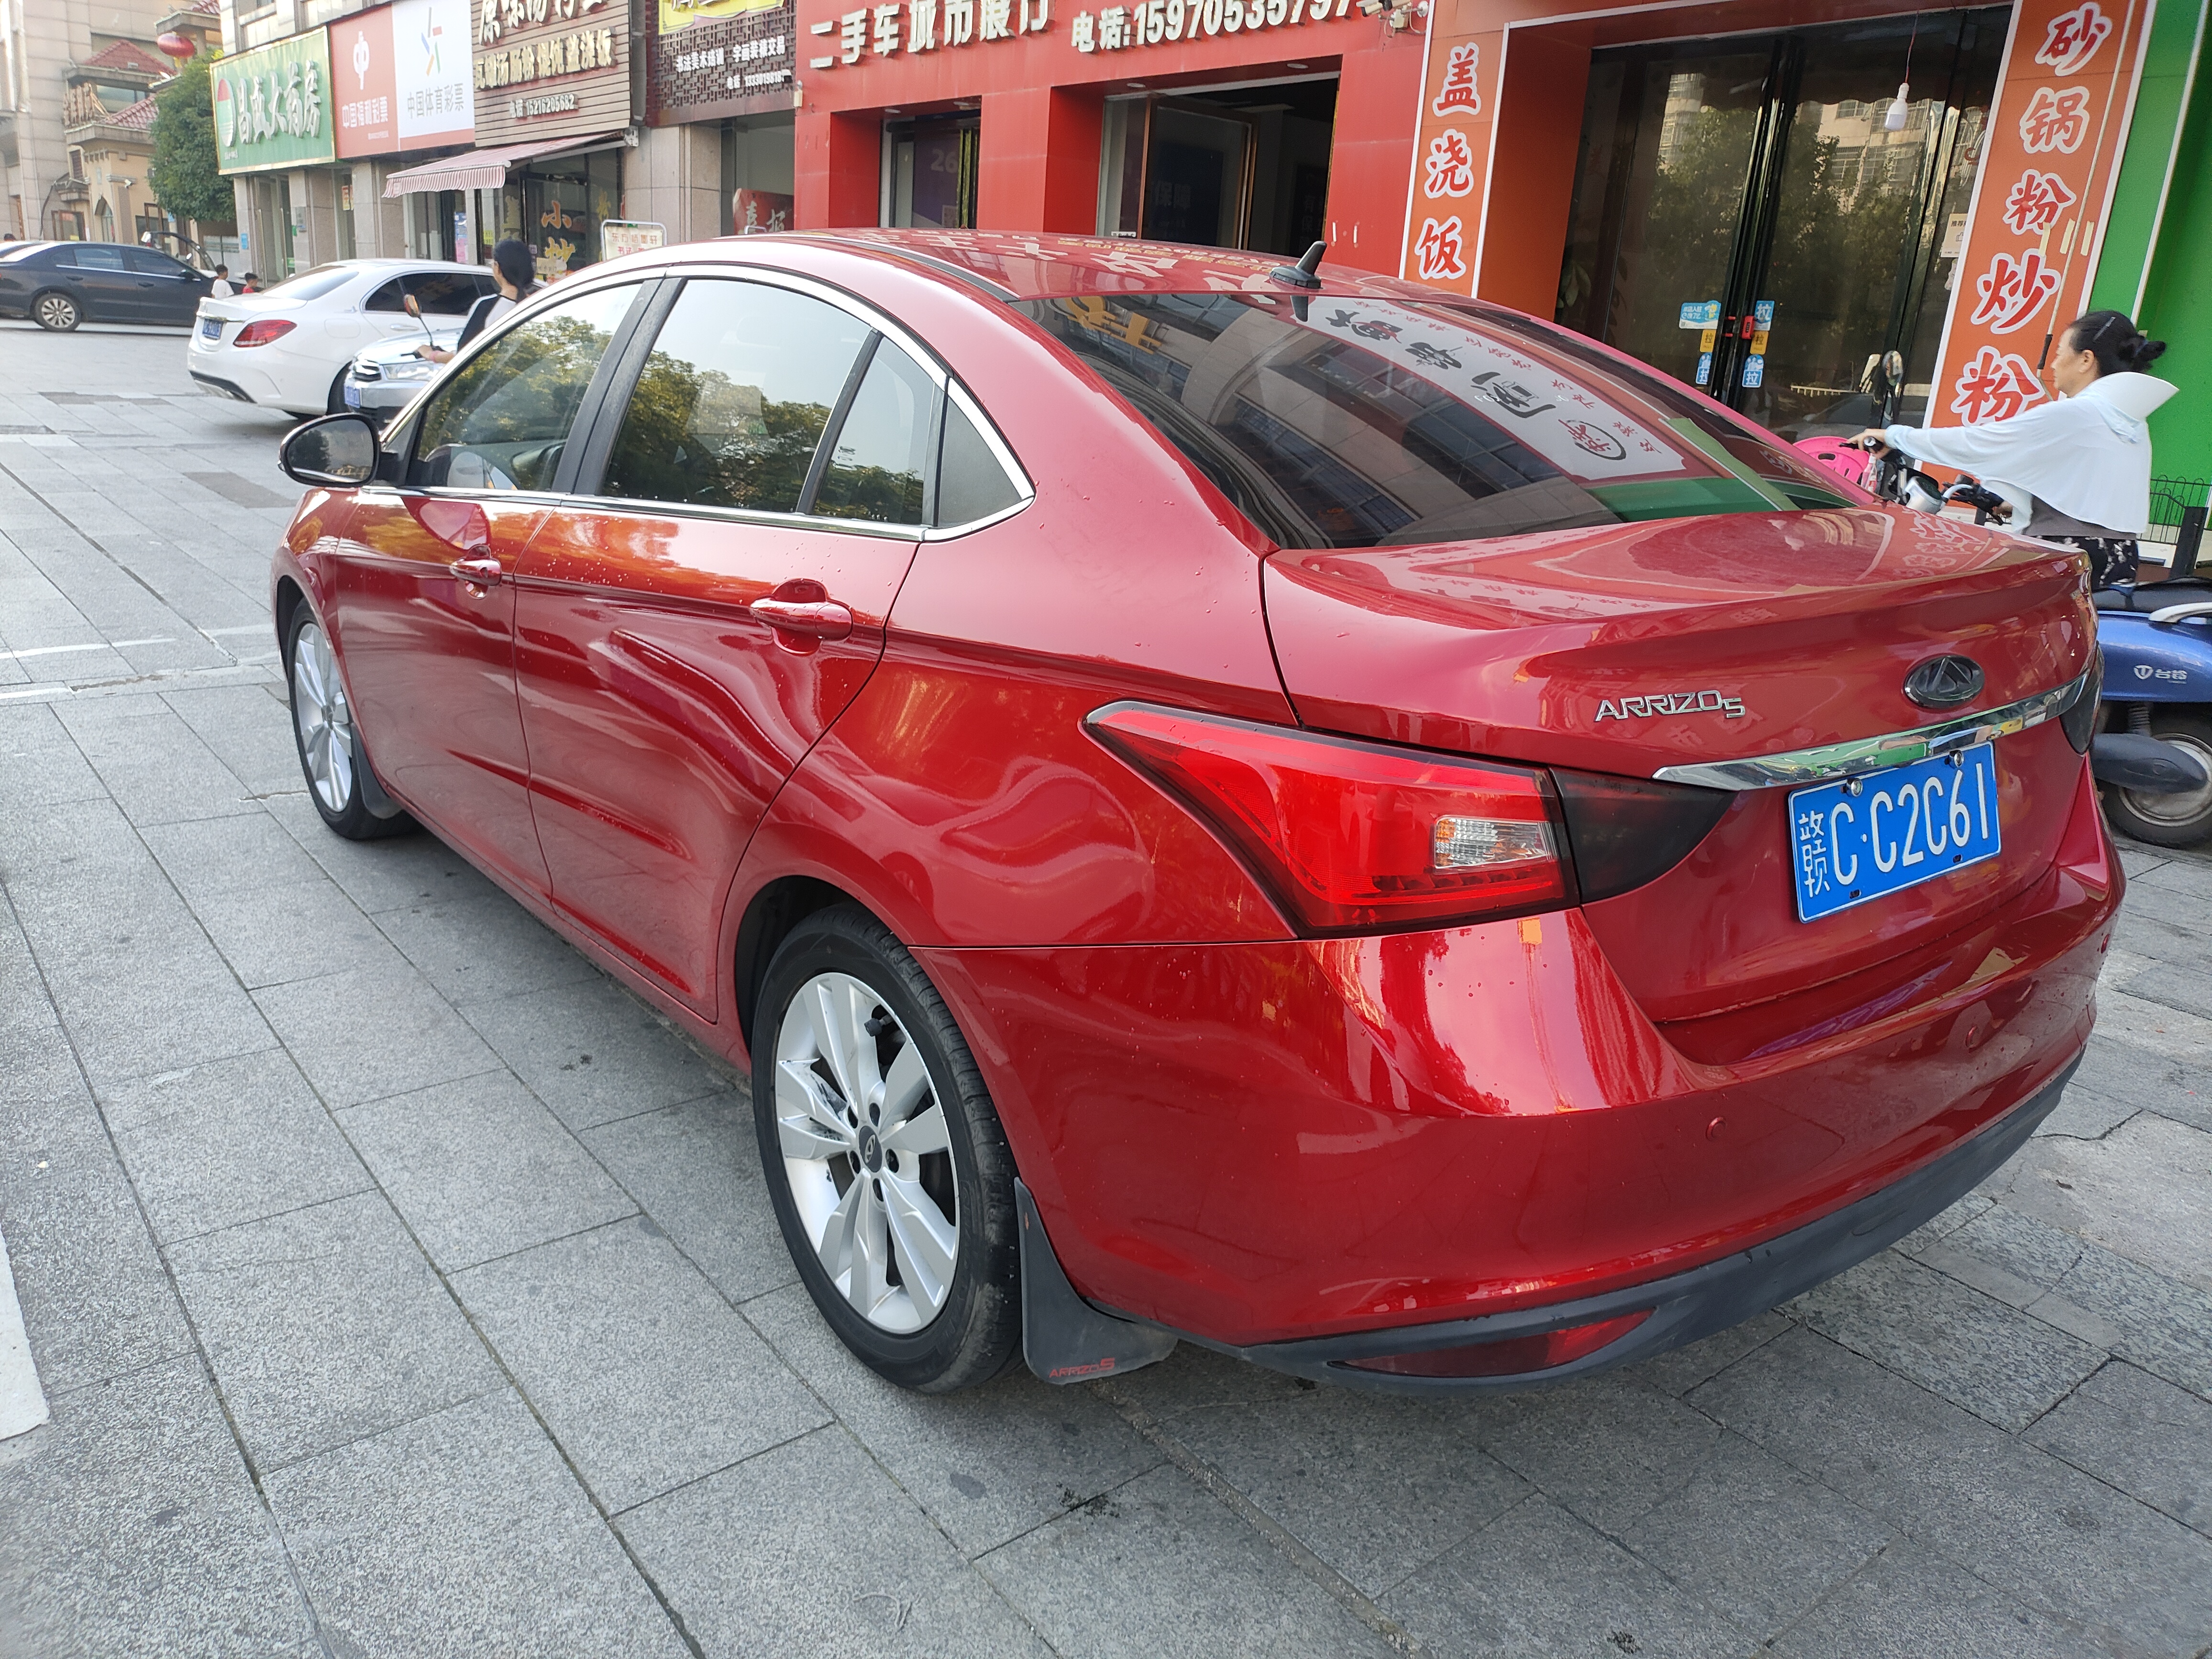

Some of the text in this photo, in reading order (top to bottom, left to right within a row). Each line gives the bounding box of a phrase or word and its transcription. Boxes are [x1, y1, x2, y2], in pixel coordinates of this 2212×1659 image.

[676, 47, 724, 73] 书法美术培训
[727, 75, 741, 90] 电话
[407, 83, 464, 119] 中国体育彩票
[509, 99, 523, 118] 电话
[342, 96, 388, 129] 中国福利彩票
[1416, 44, 1479, 277] 盖浇饭
[1705, 332, 1714, 343] 拉
[1755, 334, 1764, 345] 拉
[1746, 372, 1758, 385] 拉
